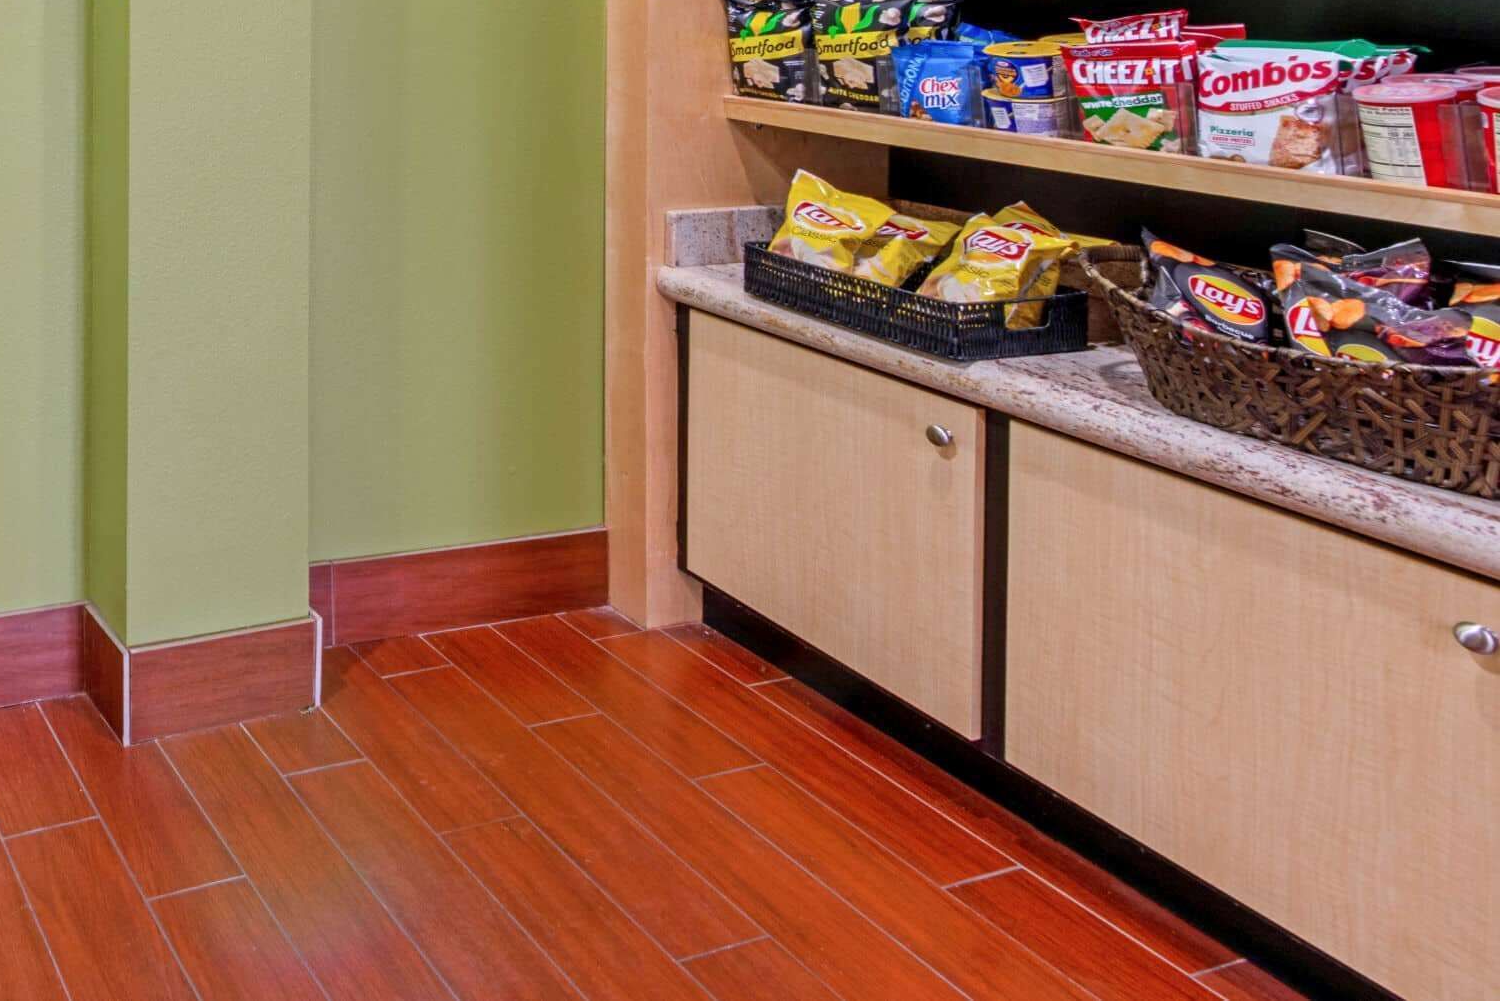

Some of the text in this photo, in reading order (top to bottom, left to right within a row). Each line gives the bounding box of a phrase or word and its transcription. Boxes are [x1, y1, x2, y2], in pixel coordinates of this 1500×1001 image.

[816, 34, 891, 56] Smartfood
[920, 77, 960, 94] Chex
[924, 93, 960, 109] mix
[1209, 126, 1255, 137] Pizzeria
[1194, 280, 1261, 315] Lay's
